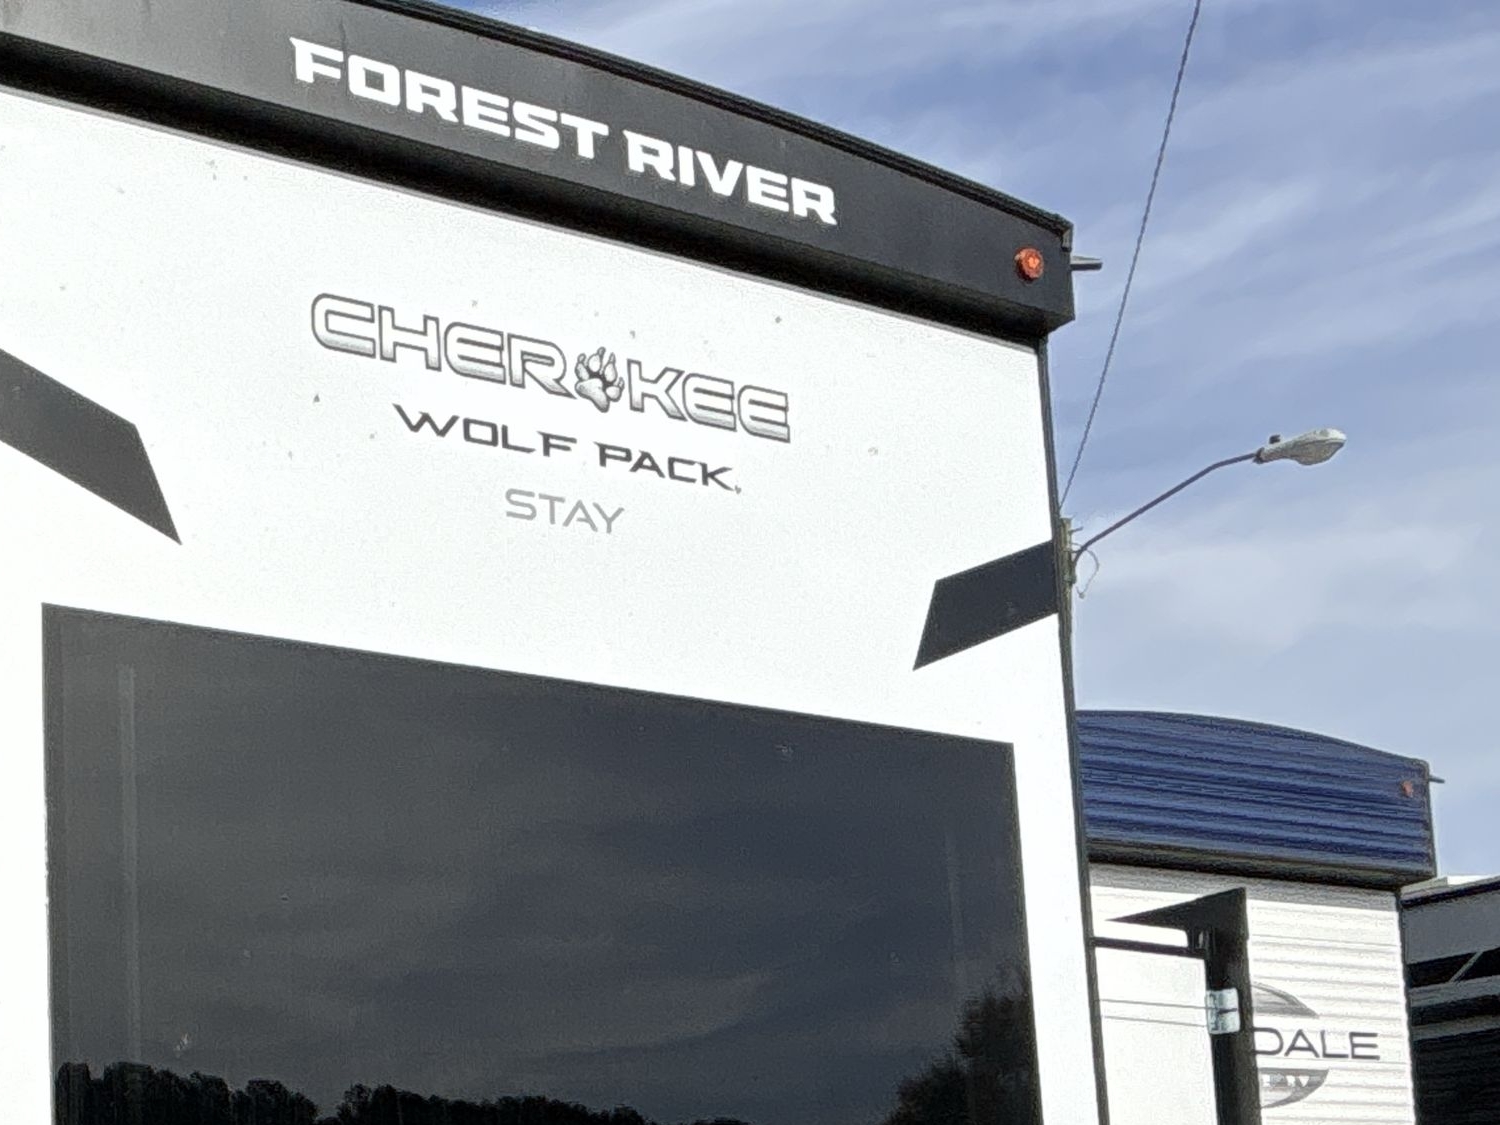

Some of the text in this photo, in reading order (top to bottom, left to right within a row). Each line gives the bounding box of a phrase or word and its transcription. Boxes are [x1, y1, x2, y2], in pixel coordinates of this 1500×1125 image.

[289, 36, 838, 226] FOREST RIVER
[392, 403, 734, 491] WOLF PACK
[505, 488, 625, 534] STAY
[1252, 1026, 1381, 1060] DALE
